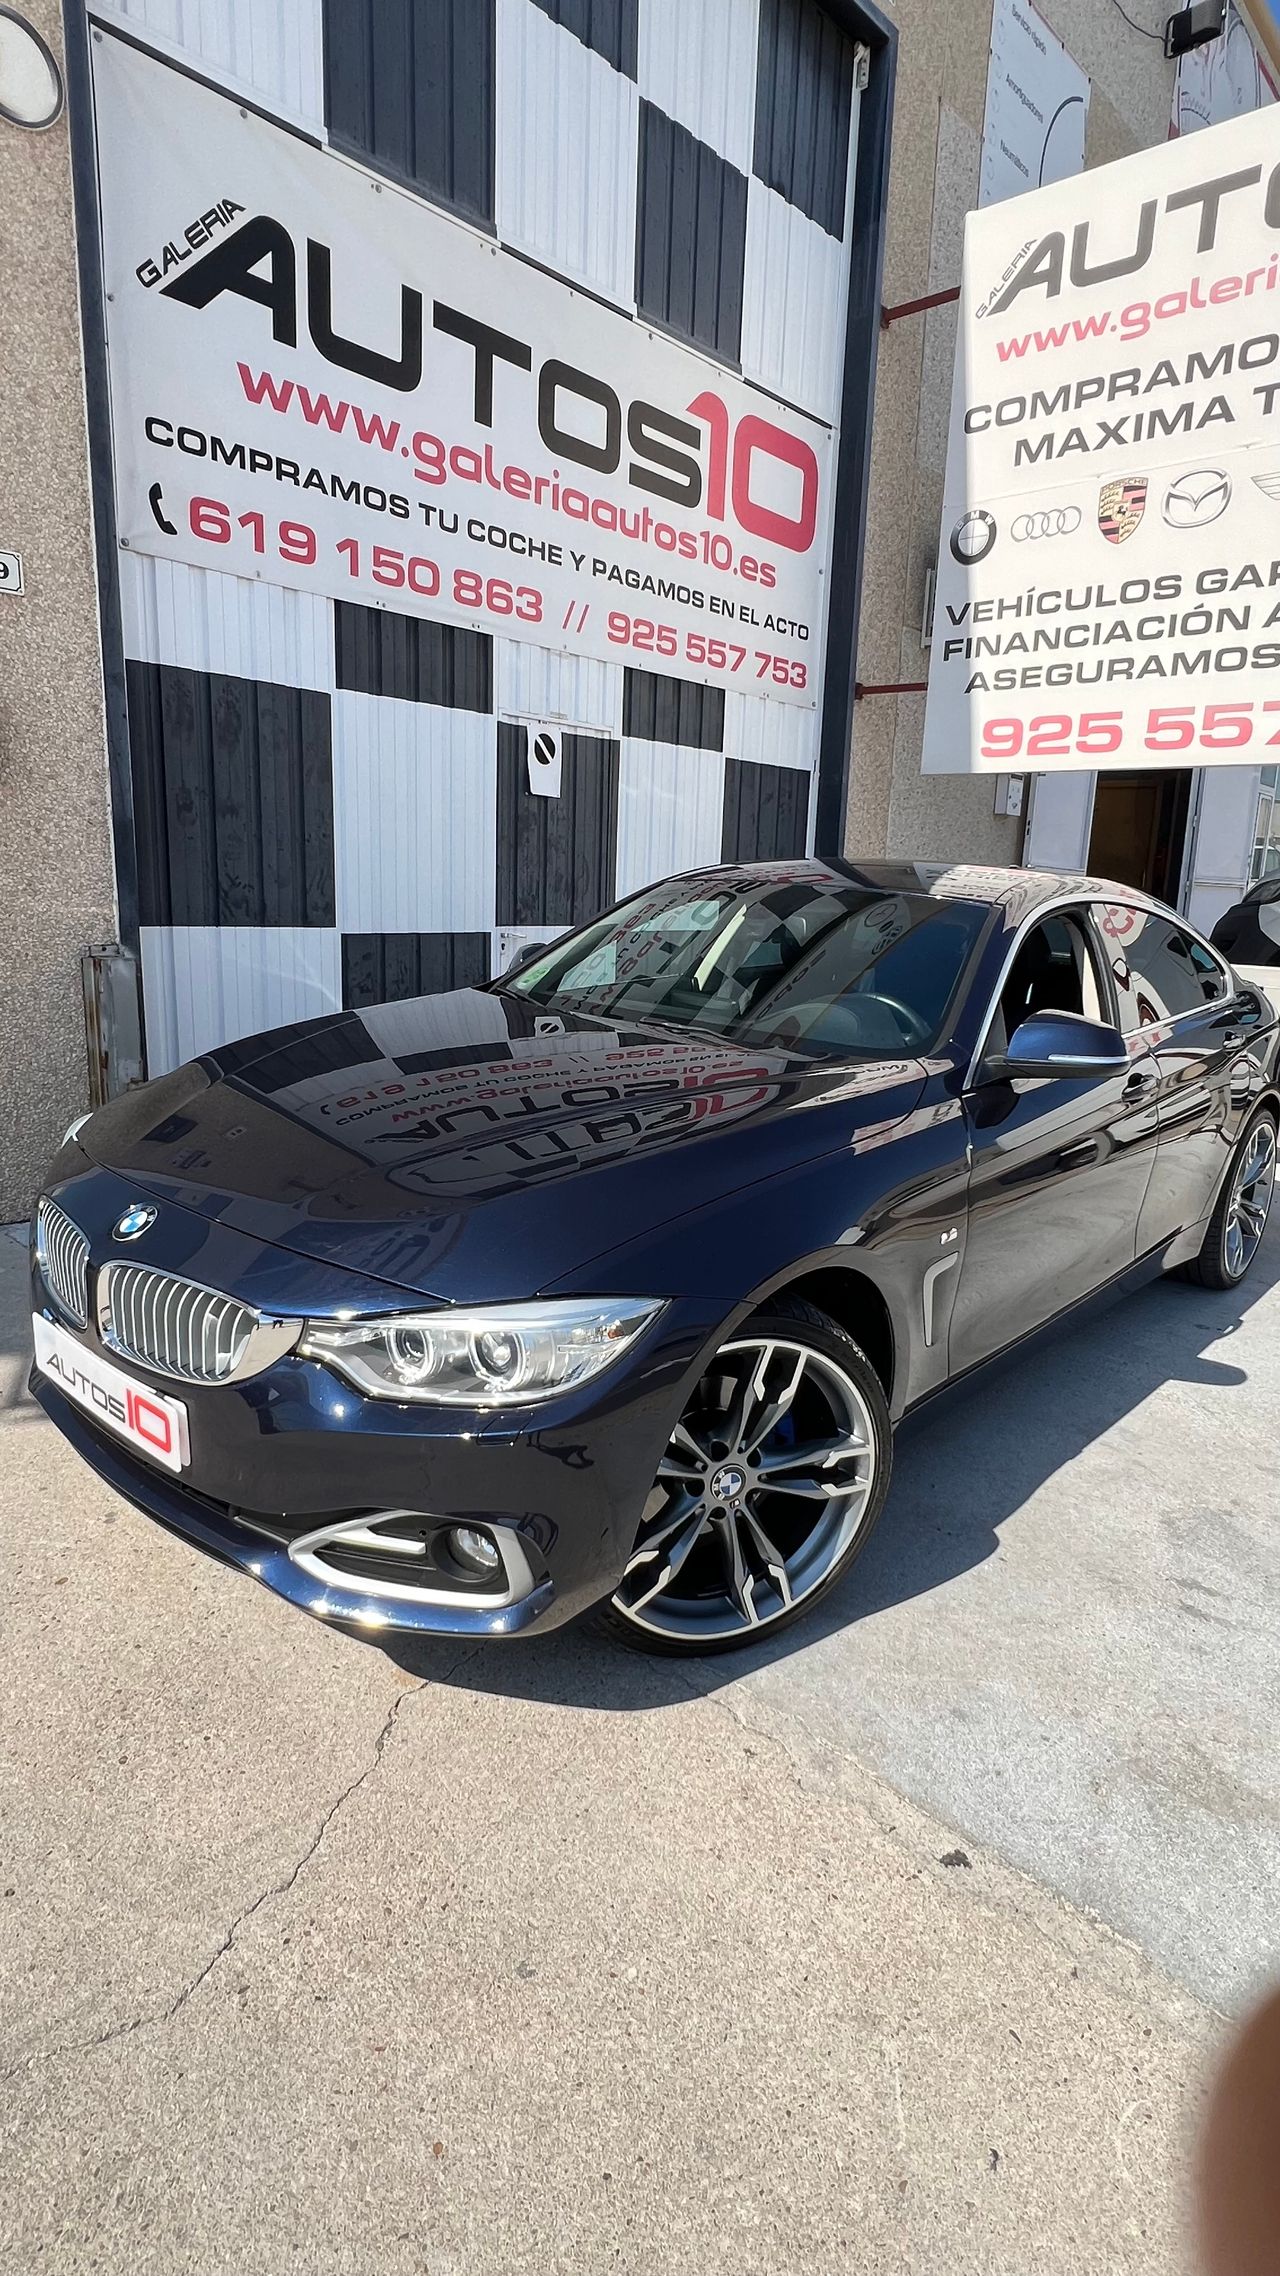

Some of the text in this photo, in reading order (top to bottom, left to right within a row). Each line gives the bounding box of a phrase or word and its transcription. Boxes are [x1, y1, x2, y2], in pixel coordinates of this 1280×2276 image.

[136, 199, 246, 288] GALERIA
[975, 238, 1038, 319] GALERIA
[159, 215, 819, 553] AUTOS10
[963, 333, 1279, 434] COMPRAMO
[236, 361, 777, 588] www.galeriaautos10.es
[1013, 395, 1236, 467] MAXIMA
[145, 416, 809, 641] COMPRAMOS TU COCHE Y PAGAMOS EN EL ACTO
[189, 496, 317, 565] 619
[336, 538, 441, 597] 150
[453, 568, 543, 623] 863
[607, 611, 678, 657] 925
[685, 632, 747, 672] 557
[754, 651, 807, 689] 753
[943, 602, 1251, 662] FINANCIACIÓN
[945, 574, 1183, 627] VEHÍCULOS
[964, 643, 1280, 694] ASEGURAMOS
[980, 710, 1123, 758] 925
[46, 1353, 172, 1454] AUTOS10
